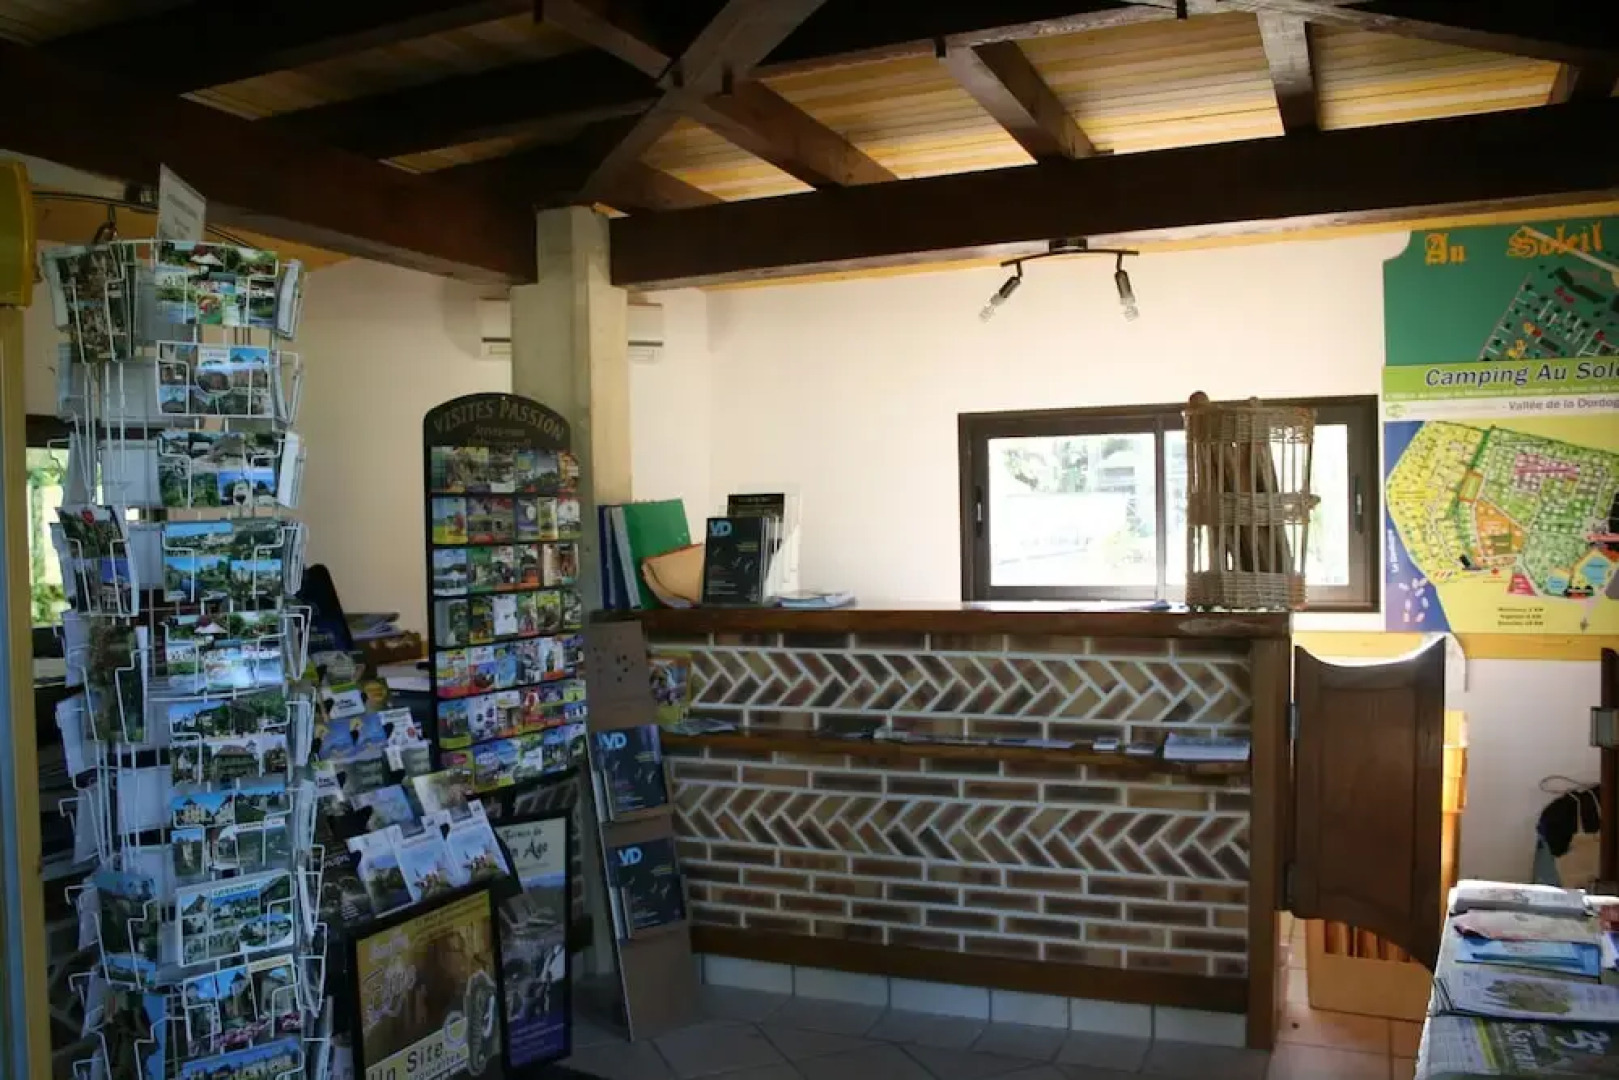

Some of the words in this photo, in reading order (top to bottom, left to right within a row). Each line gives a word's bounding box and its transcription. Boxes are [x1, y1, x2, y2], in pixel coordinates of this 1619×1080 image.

[1426, 366, 1529, 387] Camping
[1535, 367, 1567, 381] Au
[1545, 399, 1561, 410] de
[433, 399, 494, 436] VISITES
[500, 398, 565, 441] PASSION
